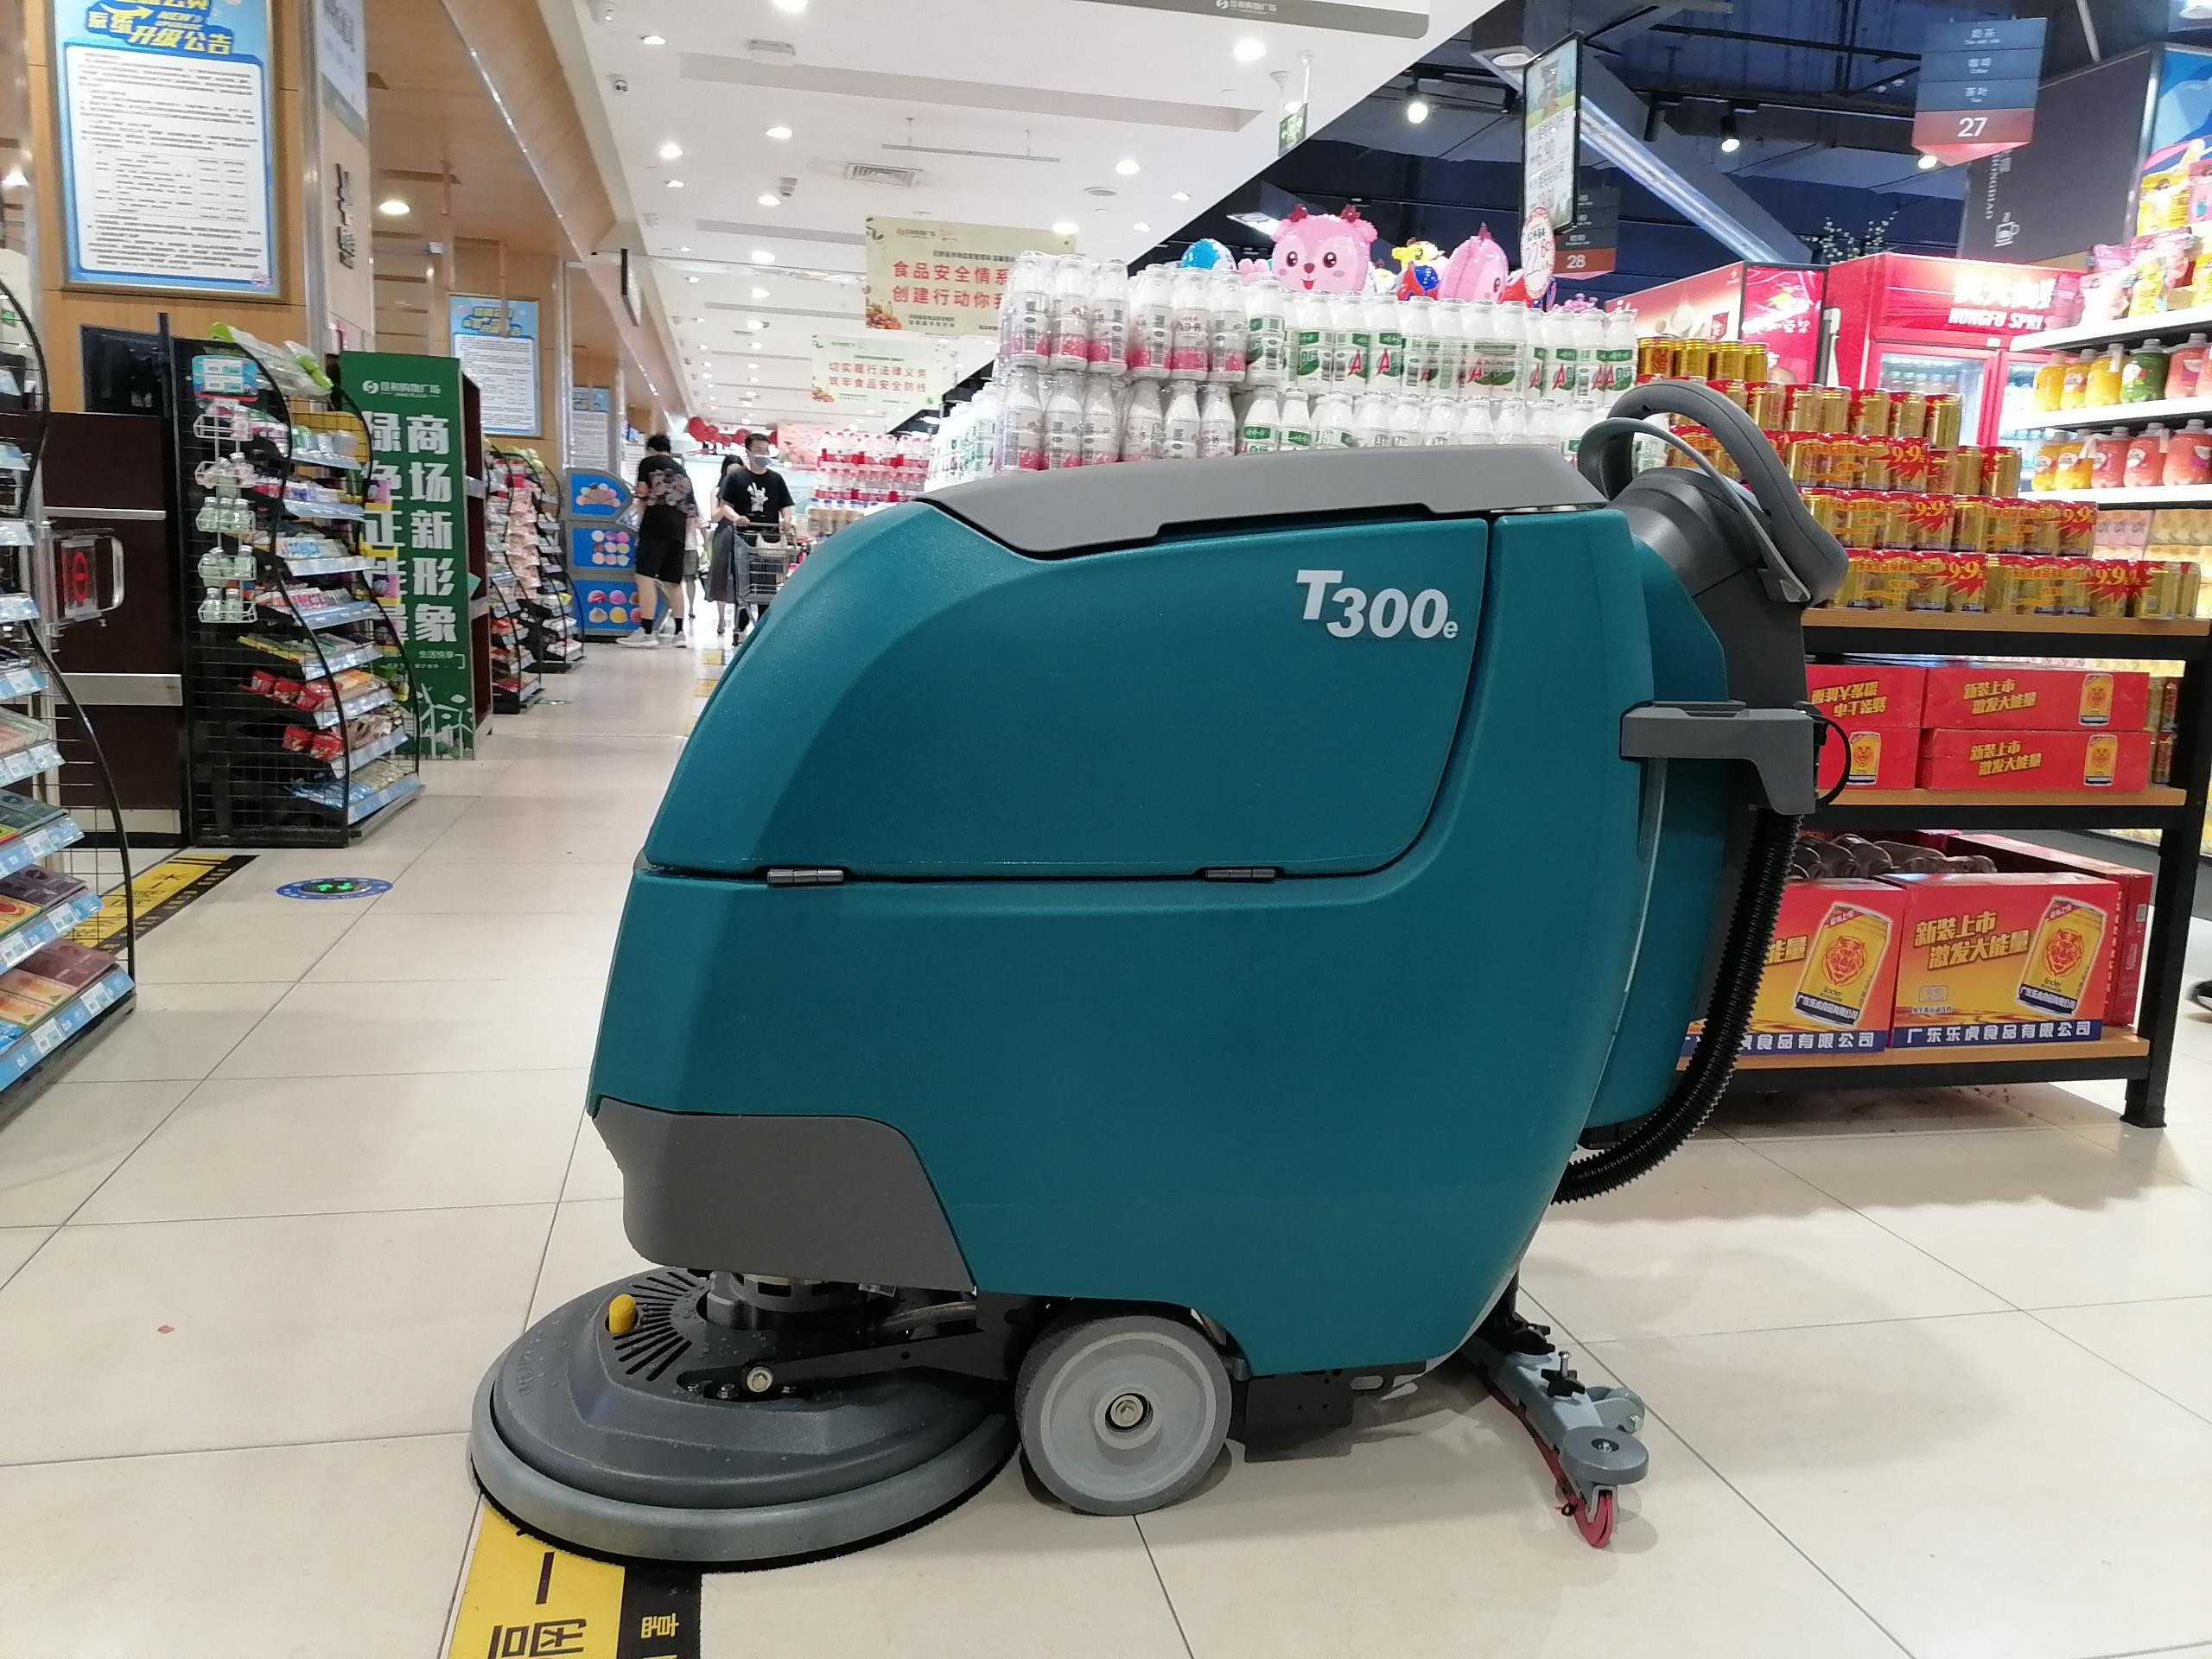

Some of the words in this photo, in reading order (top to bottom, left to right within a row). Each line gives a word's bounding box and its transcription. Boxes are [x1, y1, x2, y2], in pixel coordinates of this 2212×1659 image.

[1957, 117, 1988, 138] 27
[1566, 254, 1586, 269] 28
[406, 414, 457, 642] 商场新形象
[1296, 569, 1459, 639] T300e
[1962, 677, 2016, 700] 新装上市
[1971, 691, 2037, 715] 激发大能量
[1969, 740, 2022, 762] 新装上市
[1977, 753, 2043, 777] 激发大能量
[1913, 910, 1998, 948] 新装上市
[1927, 929, 2031, 971] 激发大能量
[1906, 1020, 2091, 1044] 广东乐虎食品有限公司
